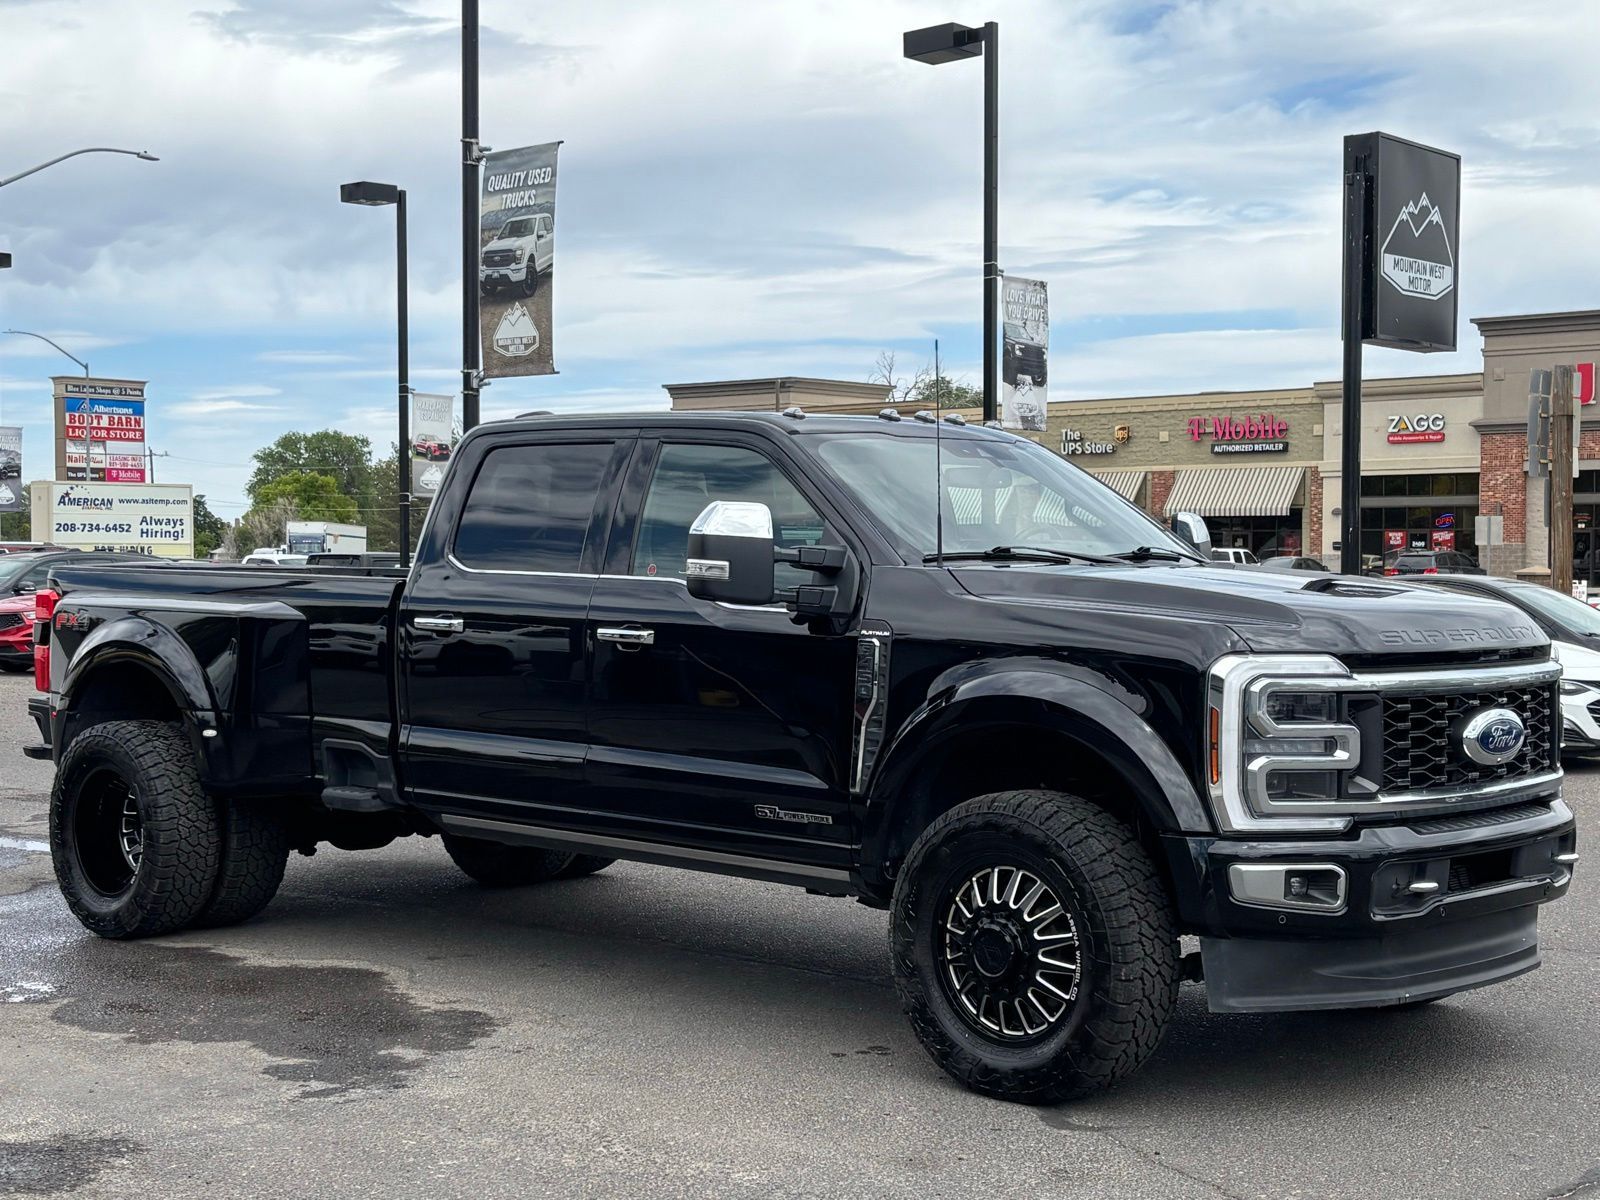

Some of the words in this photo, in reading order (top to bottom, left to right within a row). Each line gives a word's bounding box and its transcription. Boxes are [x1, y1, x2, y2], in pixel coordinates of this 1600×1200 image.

[487, 171, 527, 192] QUALITY
[527, 166, 552, 186] USED
[501, 189, 536, 210] TRUCKS
[1393, 257, 1428, 276] MOUNTAIN
[1428, 263, 1445, 281] WEST
[1408, 275, 1432, 293] MOTOR
[80, 385, 95, 393] Laes
[93, 404, 133, 414] Albertsons
[108, 415, 142, 428] BARN
[1387, 413, 1445, 433] ZAGG
[68, 428, 108, 438] LIQOR
[109, 430, 142, 439] STORE
[1061, 429, 1080, 440] The
[1061, 442, 1082, 455] UPS
[1085, 442, 1113, 454] Store
[1213, 444, 1253, 453] AUTHORIZED
[1254, 443, 1284, 451] RETAILER
[57, 495, 114, 507] AMERICAN
[55, 522, 132, 533] 208-734-6452
[140, 516, 184, 529] Always
[140, 528, 184, 541] Hiring!
[860, 629, 890, 637] PLATINUM
[1488, 725, 1516, 749] Ford
[1065, 913, 1079, 947] ARENA
